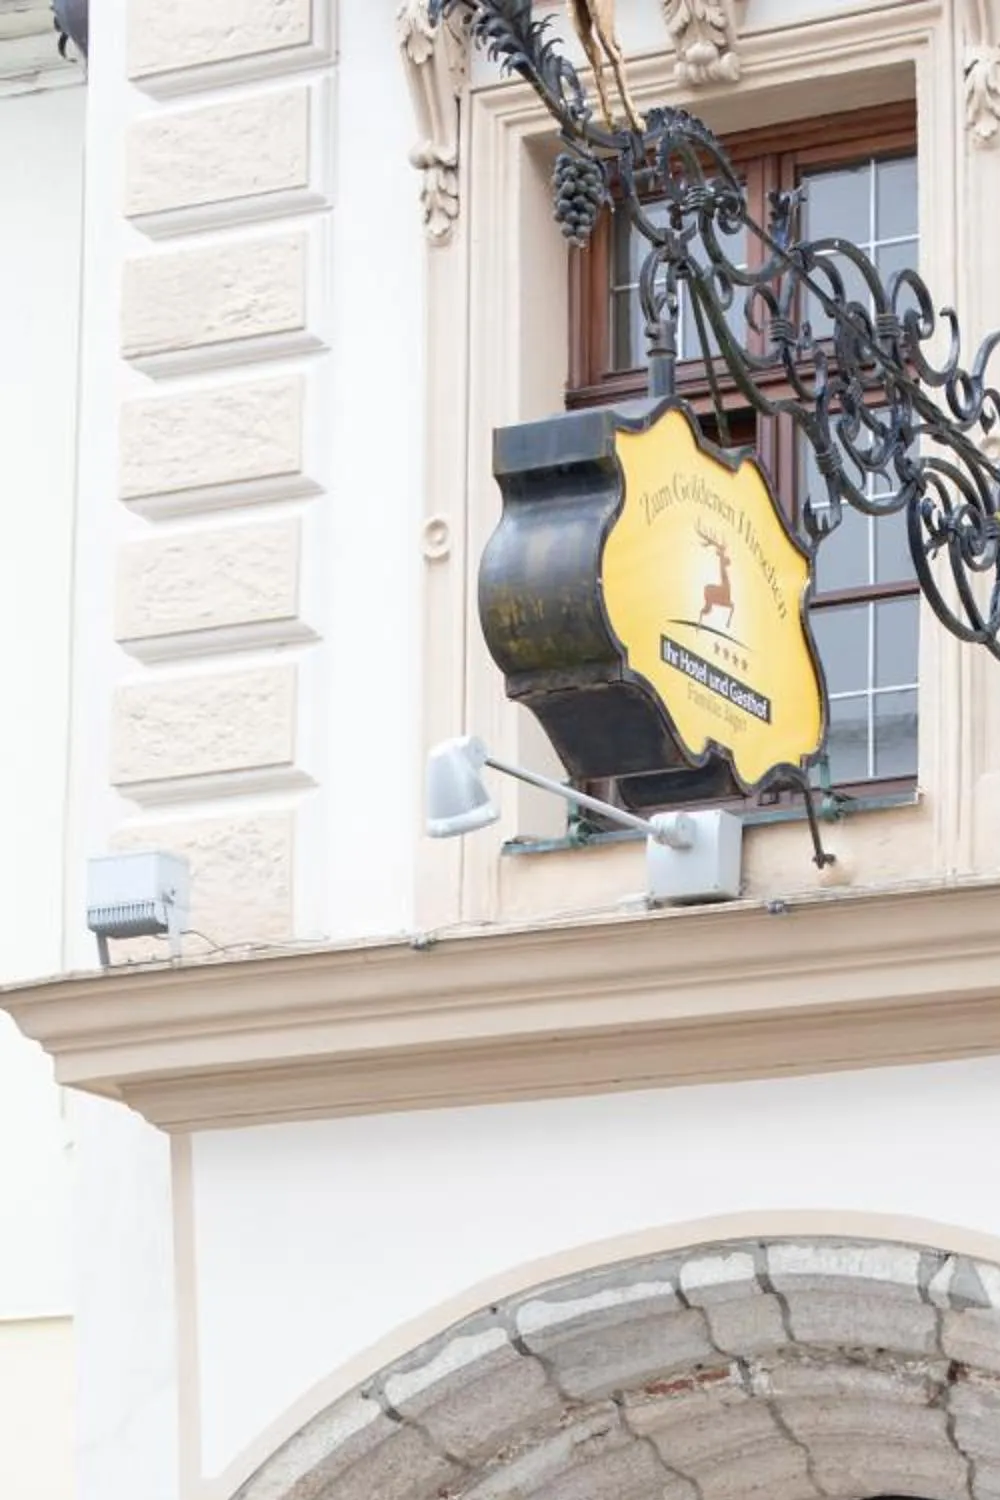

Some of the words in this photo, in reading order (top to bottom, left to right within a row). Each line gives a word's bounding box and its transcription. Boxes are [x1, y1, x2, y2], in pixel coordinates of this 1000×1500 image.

[639, 485, 673, 527] Zum
[672, 472, 736, 526] Goldenen
[735, 510, 788, 620] Hirschen
[663, 639, 679, 666] Ihr
[680, 648, 707, 684] Hotel
[708, 671, 729, 697] und
[729, 680, 768, 720] Gasthof
